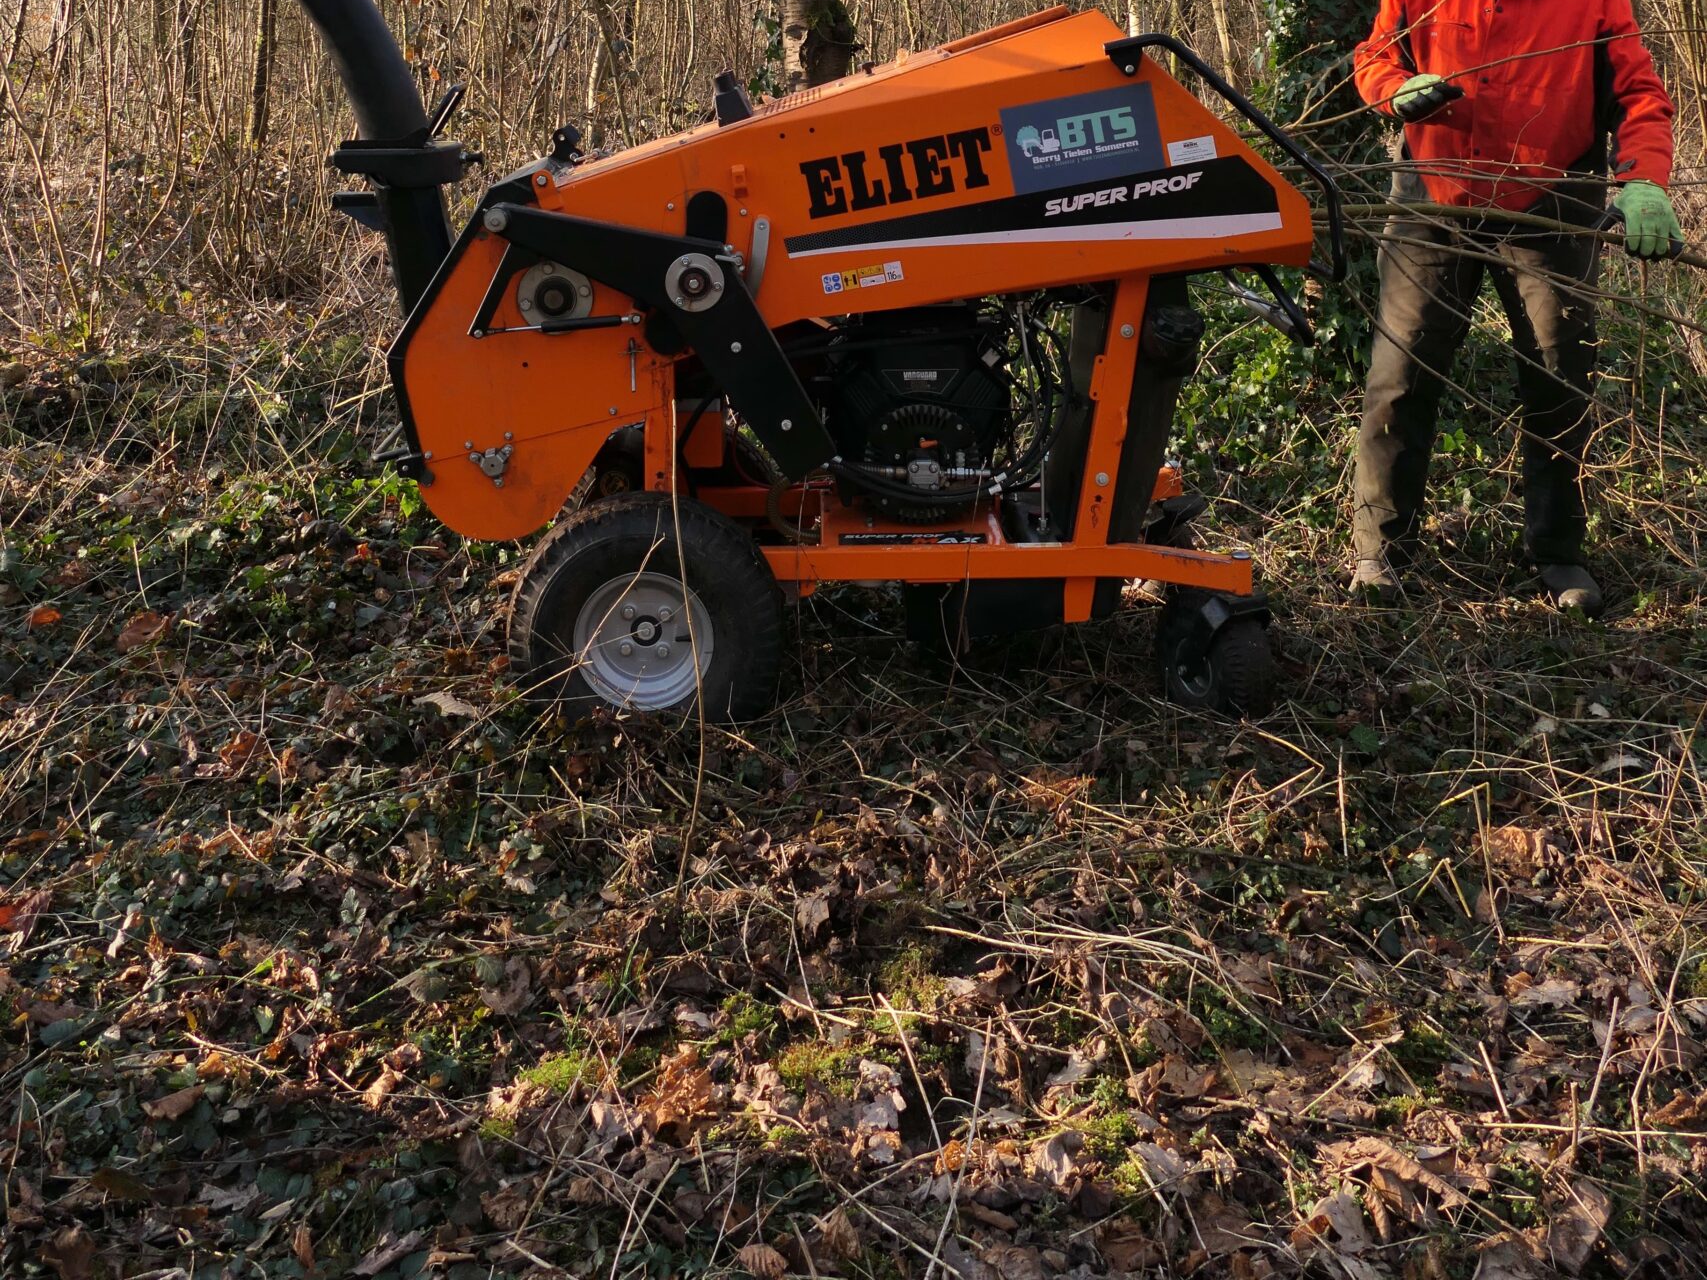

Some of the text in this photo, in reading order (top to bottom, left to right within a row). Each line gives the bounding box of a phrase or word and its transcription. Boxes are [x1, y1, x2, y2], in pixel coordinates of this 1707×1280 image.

[1057, 106, 1136, 150] BTS
[799, 126, 992, 220] ELIET
[1032, 154, 1061, 165] Berry
[1063, 148, 1092, 160] Tielen
[1095, 140, 1139, 153] Someren
[1044, 171, 1203, 217] SUPER PROF
[903, 371, 937, 379] VANGUARD
